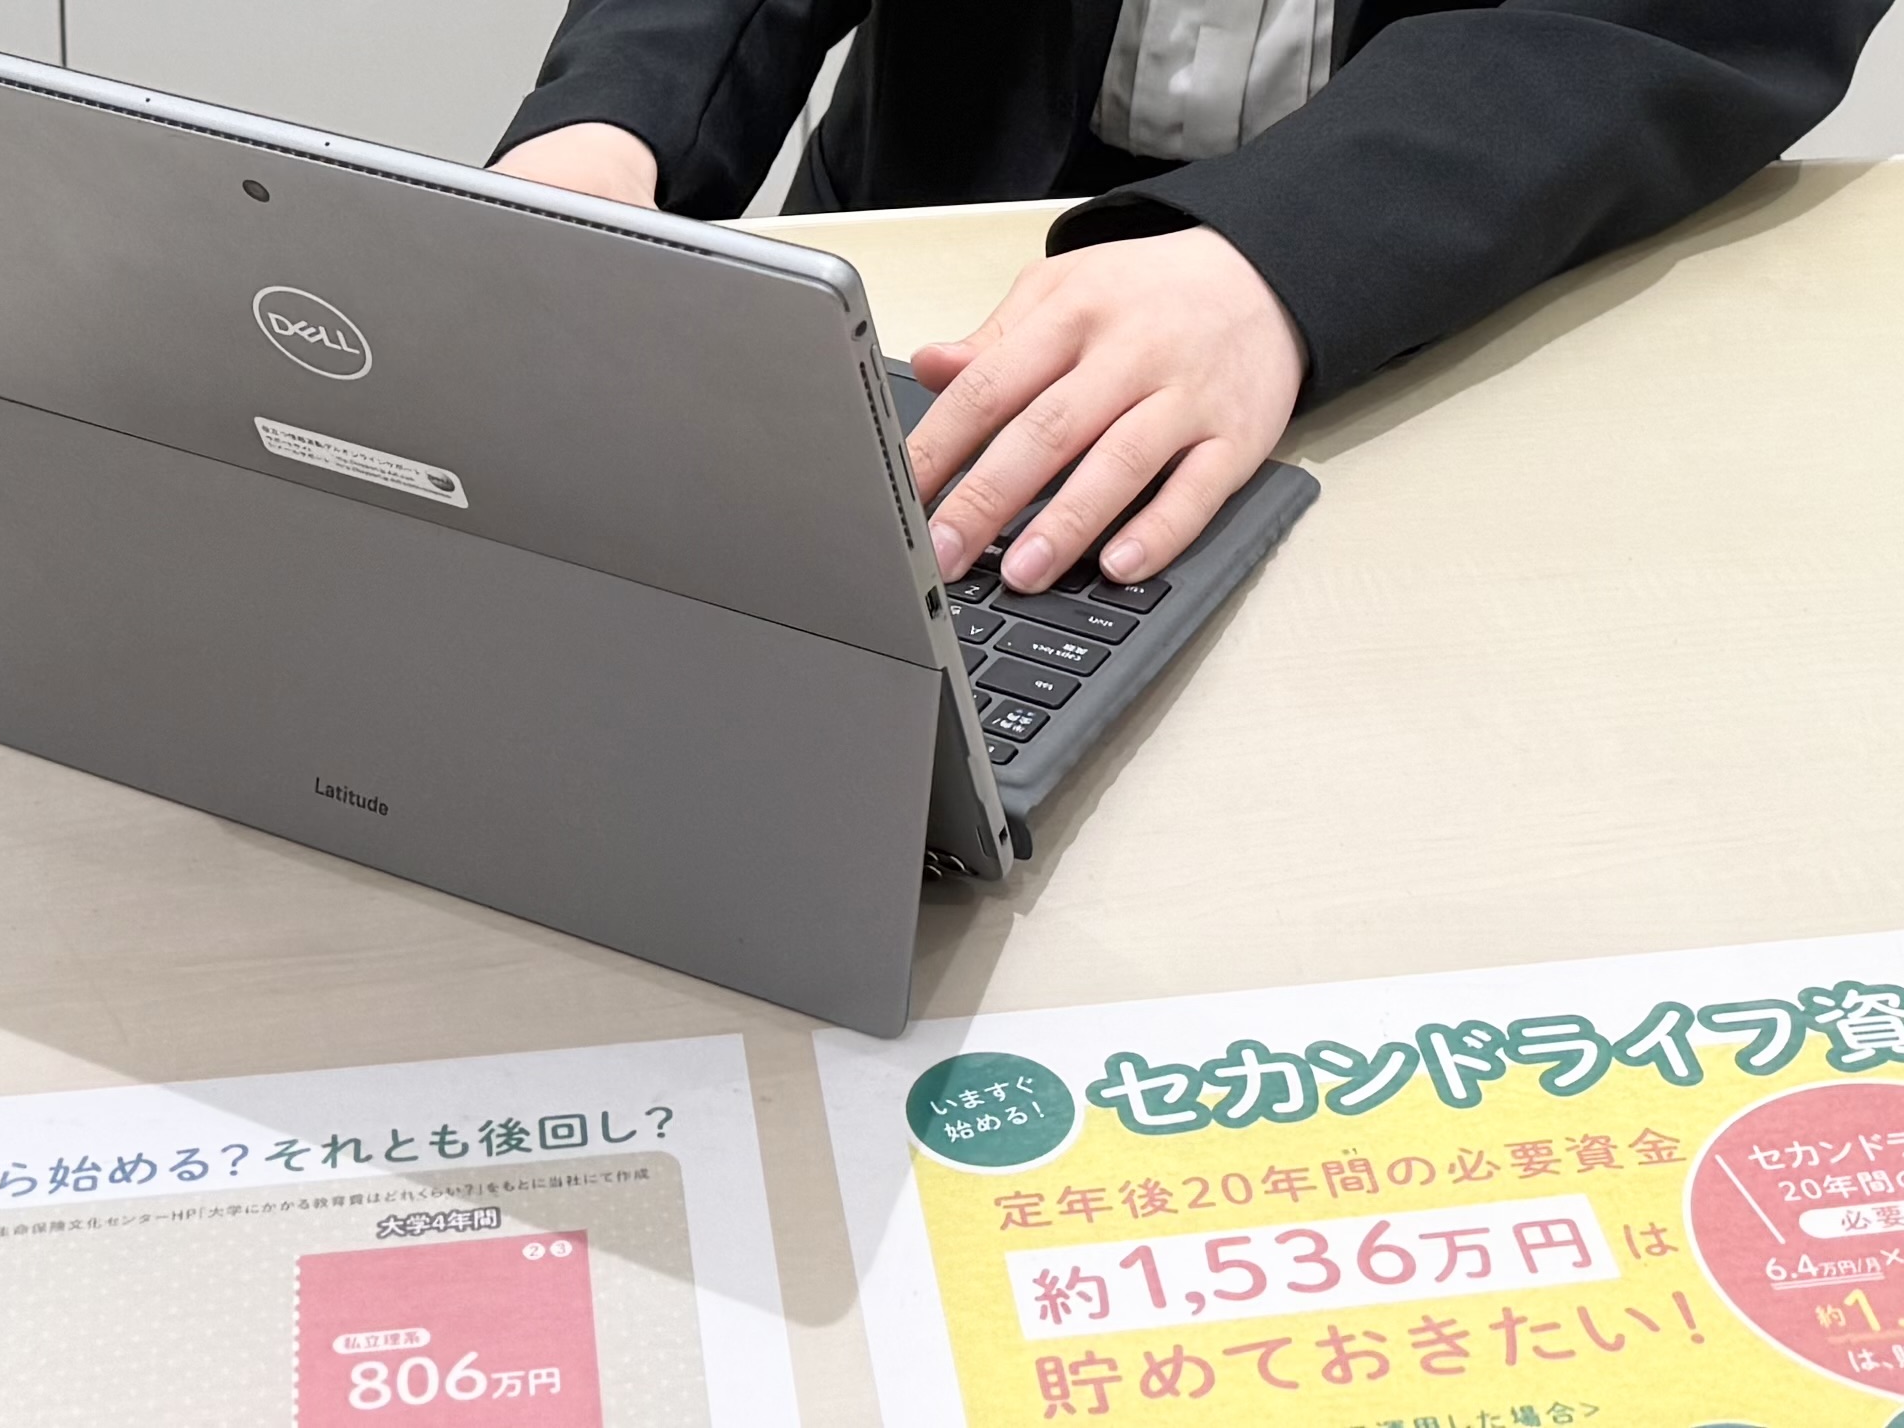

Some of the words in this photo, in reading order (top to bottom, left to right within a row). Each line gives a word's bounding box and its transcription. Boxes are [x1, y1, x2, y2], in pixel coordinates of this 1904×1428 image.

[267, 311, 361, 355] DELL
[314, 776, 389, 816] Latitude
[930, 1075, 1036, 1116] いますぐ
[944, 1100, 1047, 1144] 始める!
[994, 1127, 1687, 1232] 定年後20年間の必要資金
[379, 1208, 500, 1238] 大学4年間
[1032, 1218, 1593, 1326] 約1,536万円
[1035, 1290, 1707, 1420] 貯めておきたい!
[348, 1351, 561, 1411] 806万円
